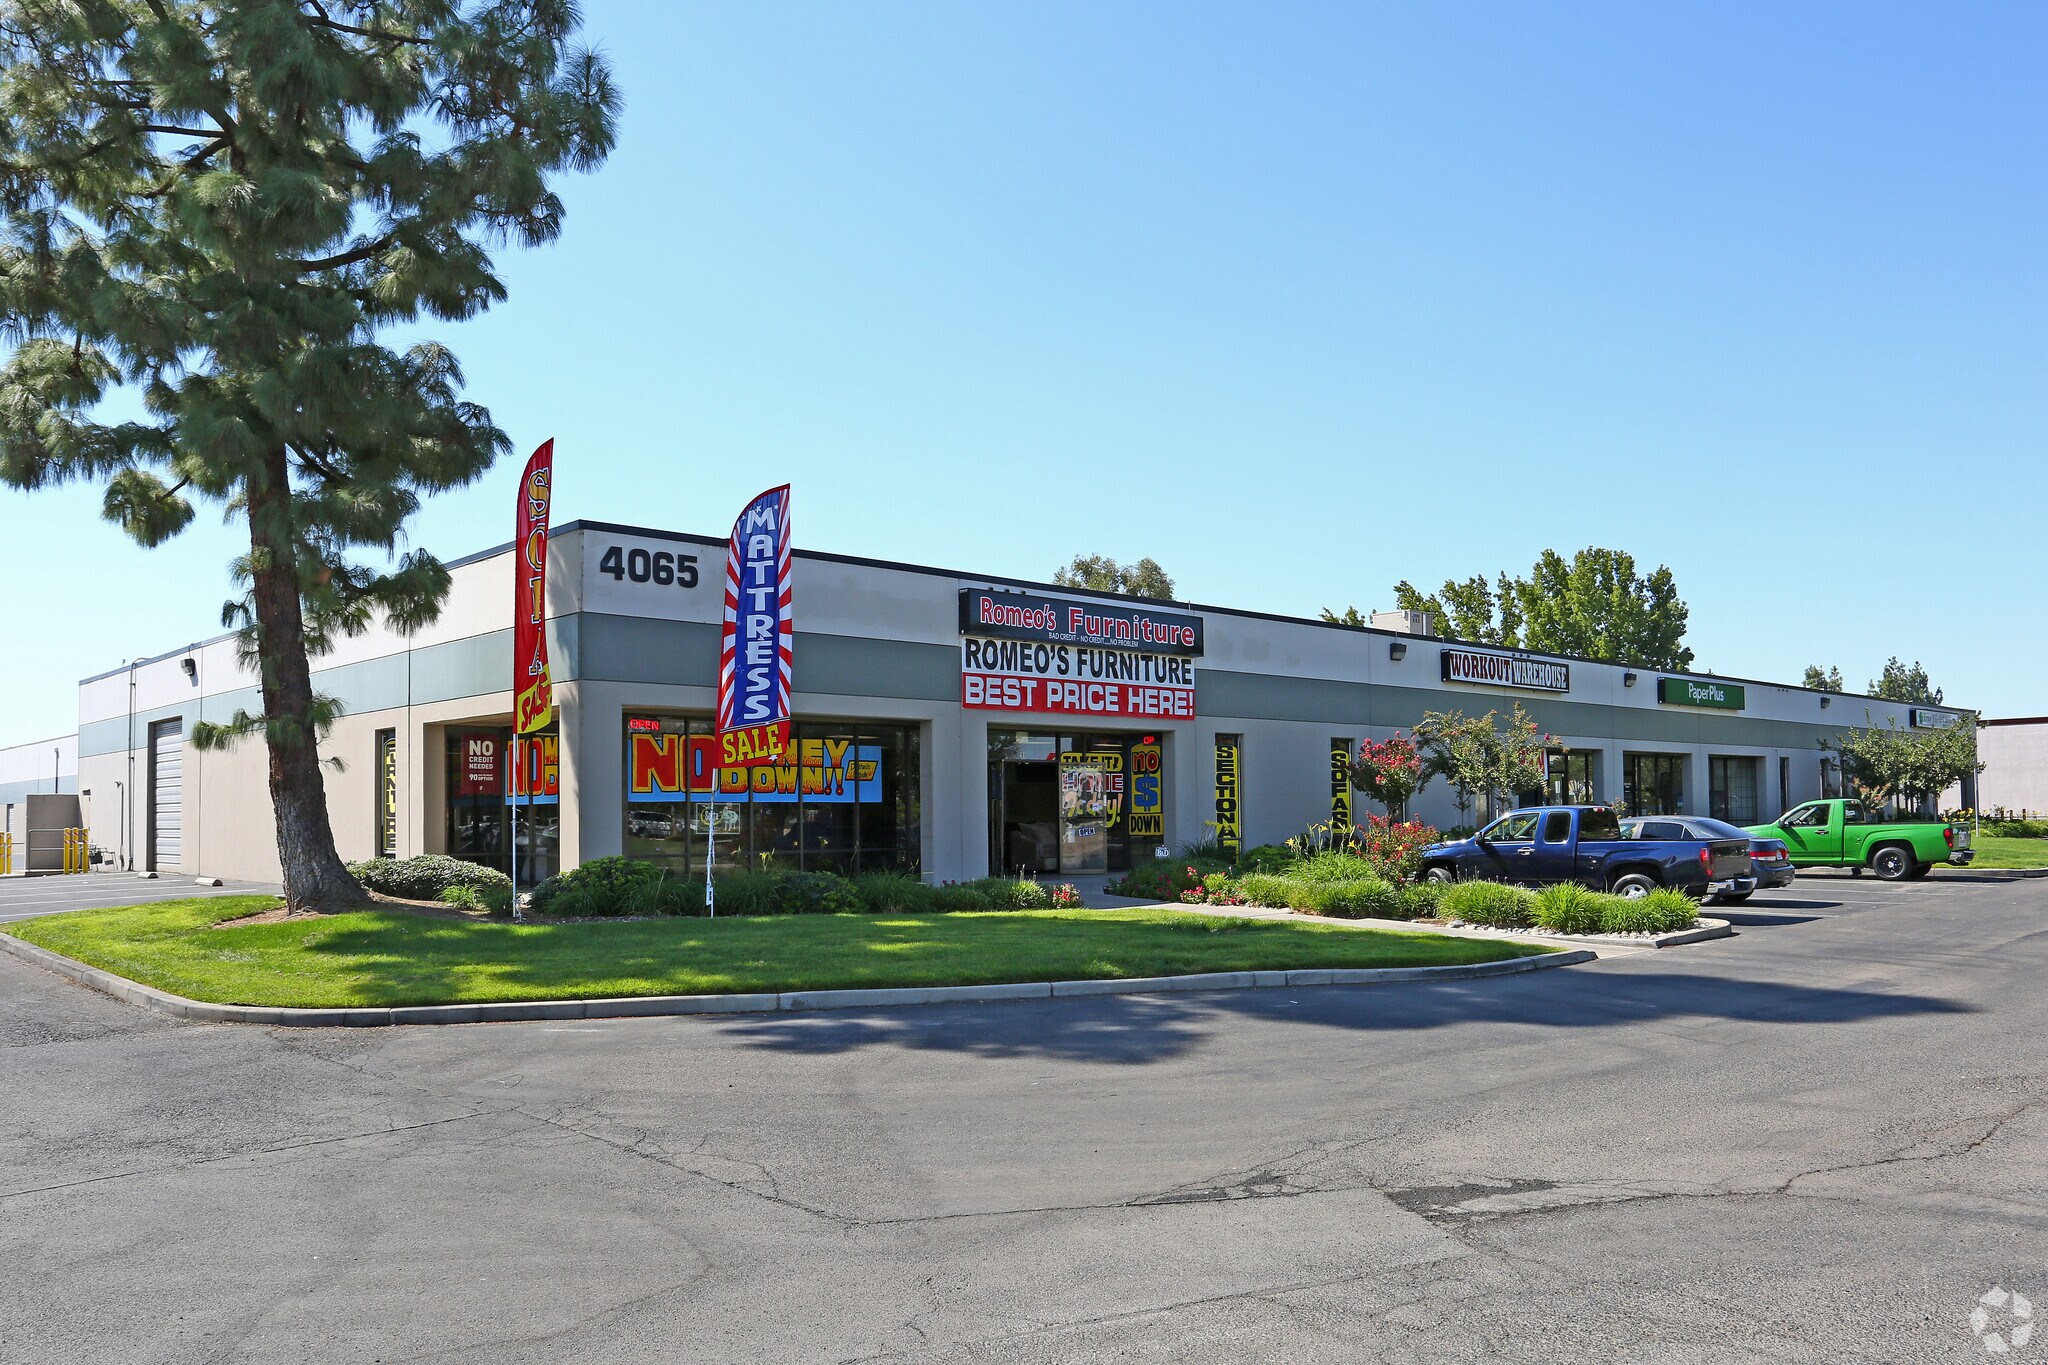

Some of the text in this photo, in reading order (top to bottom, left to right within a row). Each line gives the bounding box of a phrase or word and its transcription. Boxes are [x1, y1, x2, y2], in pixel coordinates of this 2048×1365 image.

[600, 545, 699, 589] 4065
[744, 508, 777, 720] MATTRESS
[979, 596, 1195, 647] Romeo's Furniture
[1049, 632, 1060, 640] BAD
[1060, 633, 1076, 642] CREDIT
[1118, 639, 1139, 648] PROBLEM
[965, 637, 1193, 685] ROMEO'S FURNITURE
[1449, 653, 1567, 689] WORKOUT WAREHOUSE
[965, 676, 1194, 716] BEST PRICE HERE!
[629, 718, 660, 731] OPEN
[469, 740, 493, 756] NO
[722, 724, 783, 764] SALE
[1063, 755, 1120, 770] TAKE IT!
[1132, 750, 1160, 775] no
[469, 773, 478, 781] 90
[507, 738, 543, 797] NO
[631, 733, 850, 794] NO NEY
[720, 766, 845, 797] DOWN!!
[1134, 773, 1159, 813] $
[1331, 752, 1349, 830] SOFAS
[1079, 828, 1095, 836] OPEN
[1130, 815, 1161, 833] DOWN
